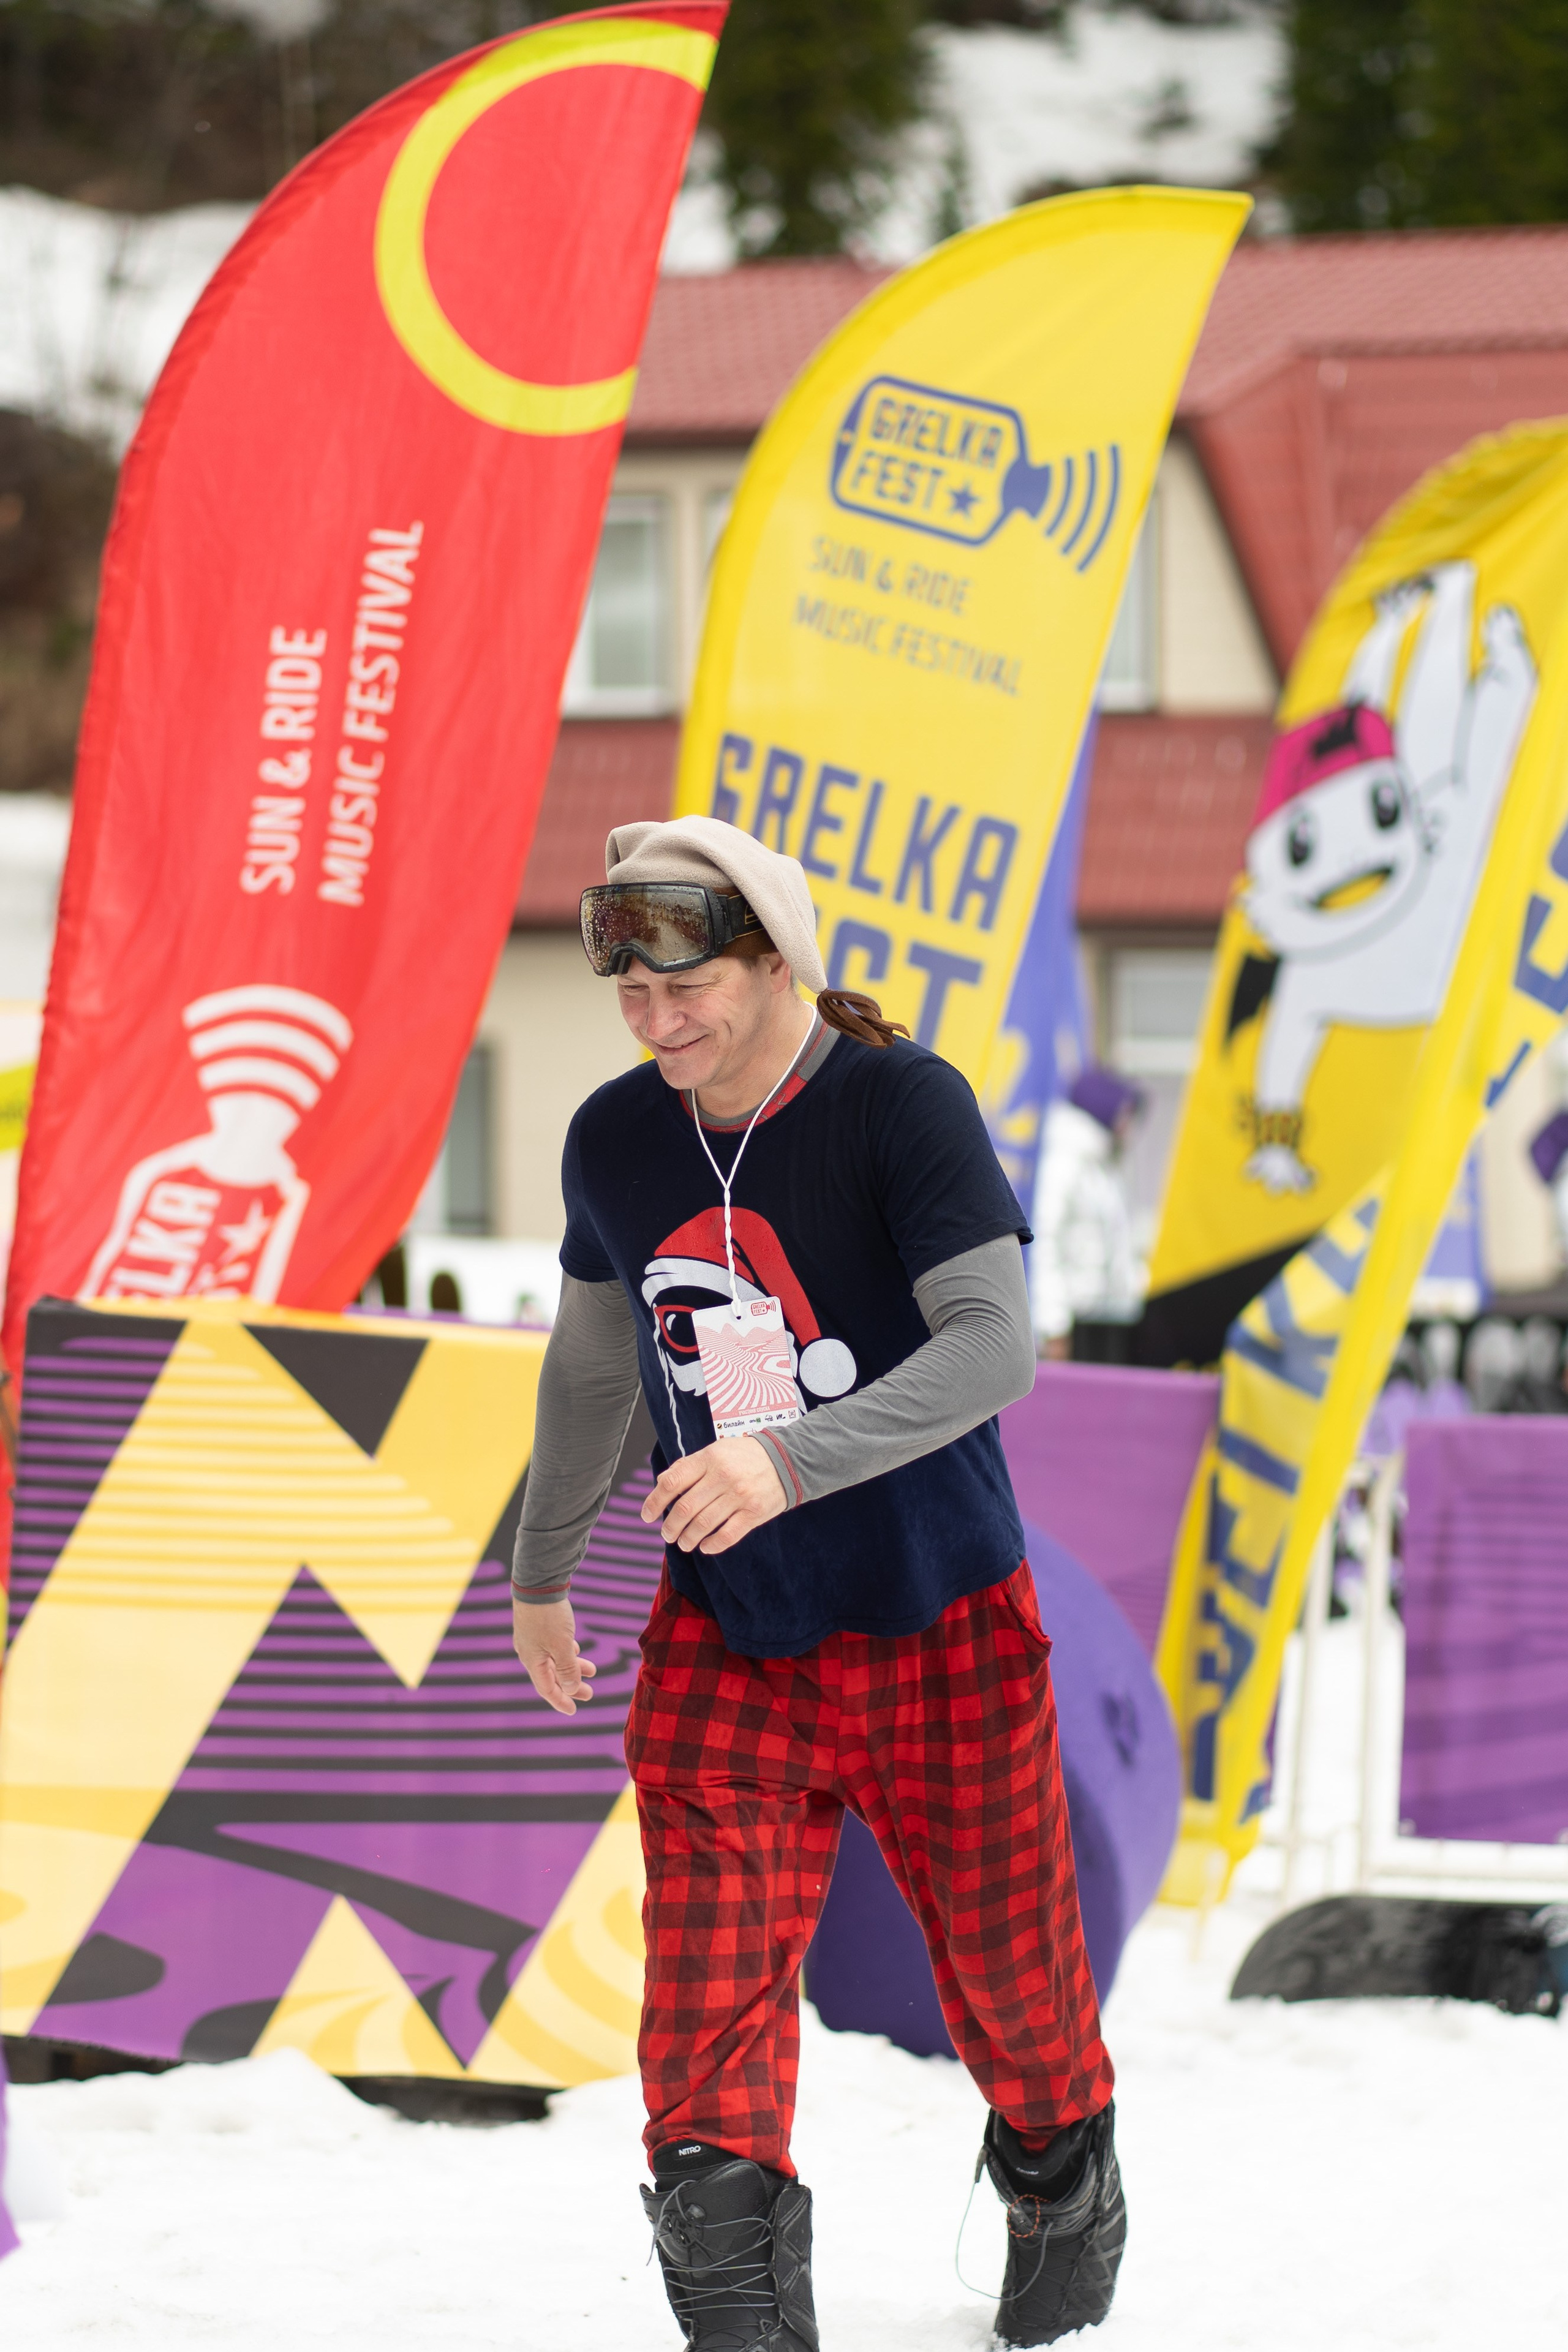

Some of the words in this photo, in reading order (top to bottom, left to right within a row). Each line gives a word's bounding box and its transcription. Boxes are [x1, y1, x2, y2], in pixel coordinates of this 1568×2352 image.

[850, 450, 945, 511] FEST
[869, 397, 1004, 472] GRELKA
[809, 534, 869, 584] SUN
[900, 562, 973, 616] RIDE
[341, 519, 425, 743] FESTIVAL
[793, 592, 889, 656] MUSIC
[889, 621, 1023, 697] FESTIVAL
[260, 624, 328, 741] RIDE
[258, 747, 313, 790] &
[239, 796, 307, 895] SUN
[317, 745, 385, 908] MUSIC
[710, 733, 1020, 933] GRELKA
[812, 905, 984, 1051] ST
[105, 1180, 222, 1300] LKA
[723, 1420, 745, 1428] билайн
[678, 2145, 701, 2156] NITRO
